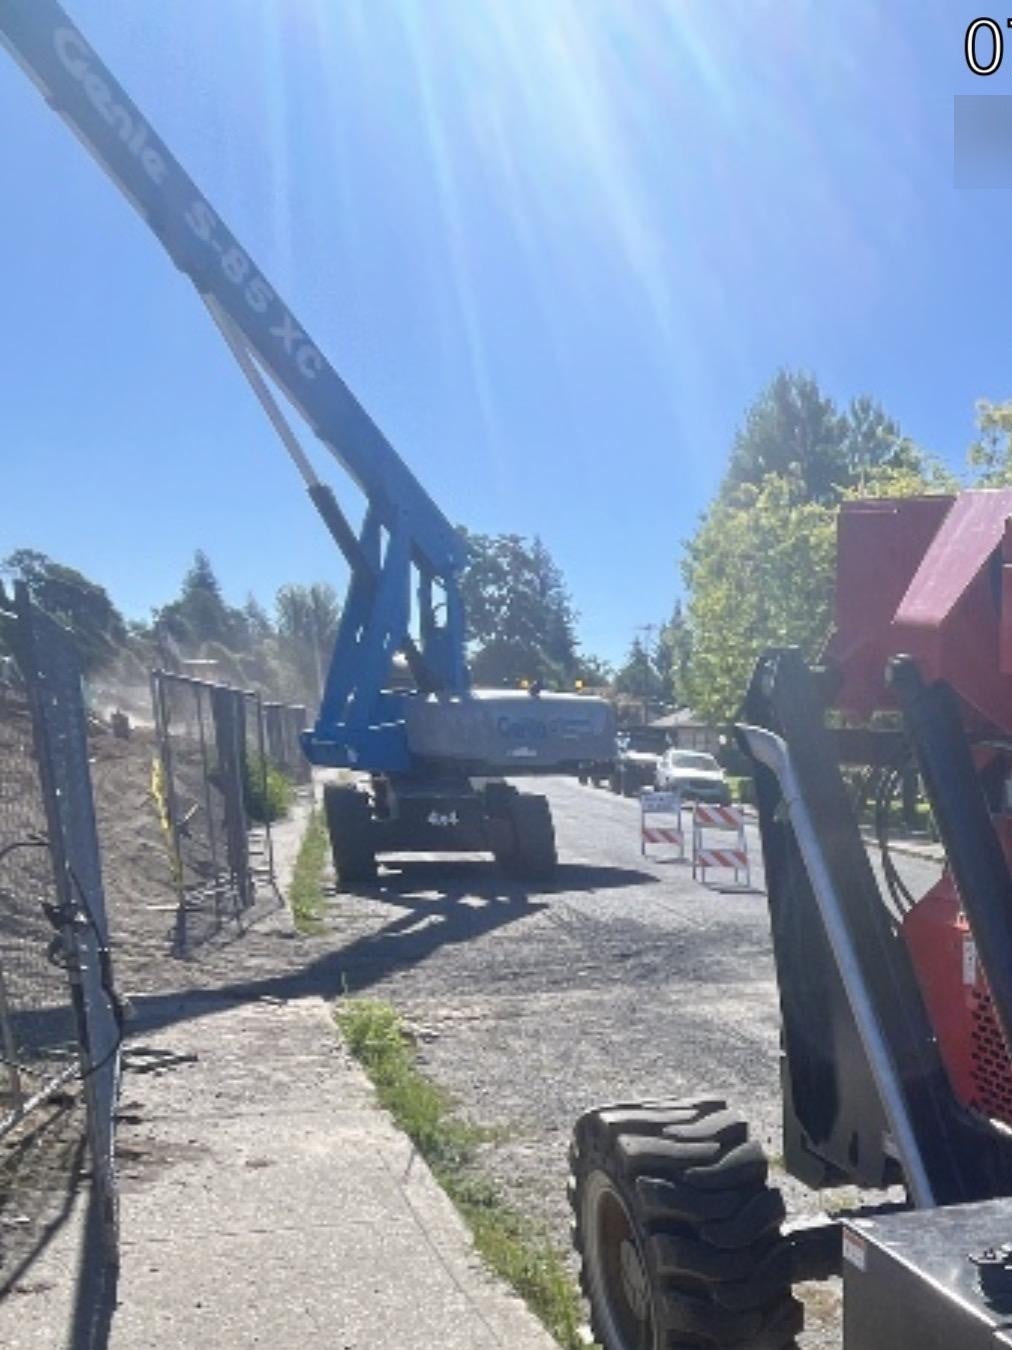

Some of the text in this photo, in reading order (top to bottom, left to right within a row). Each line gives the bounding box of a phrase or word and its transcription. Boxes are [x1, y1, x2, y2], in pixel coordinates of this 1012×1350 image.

[53, 26, 323, 379] Genie S-85 XC
